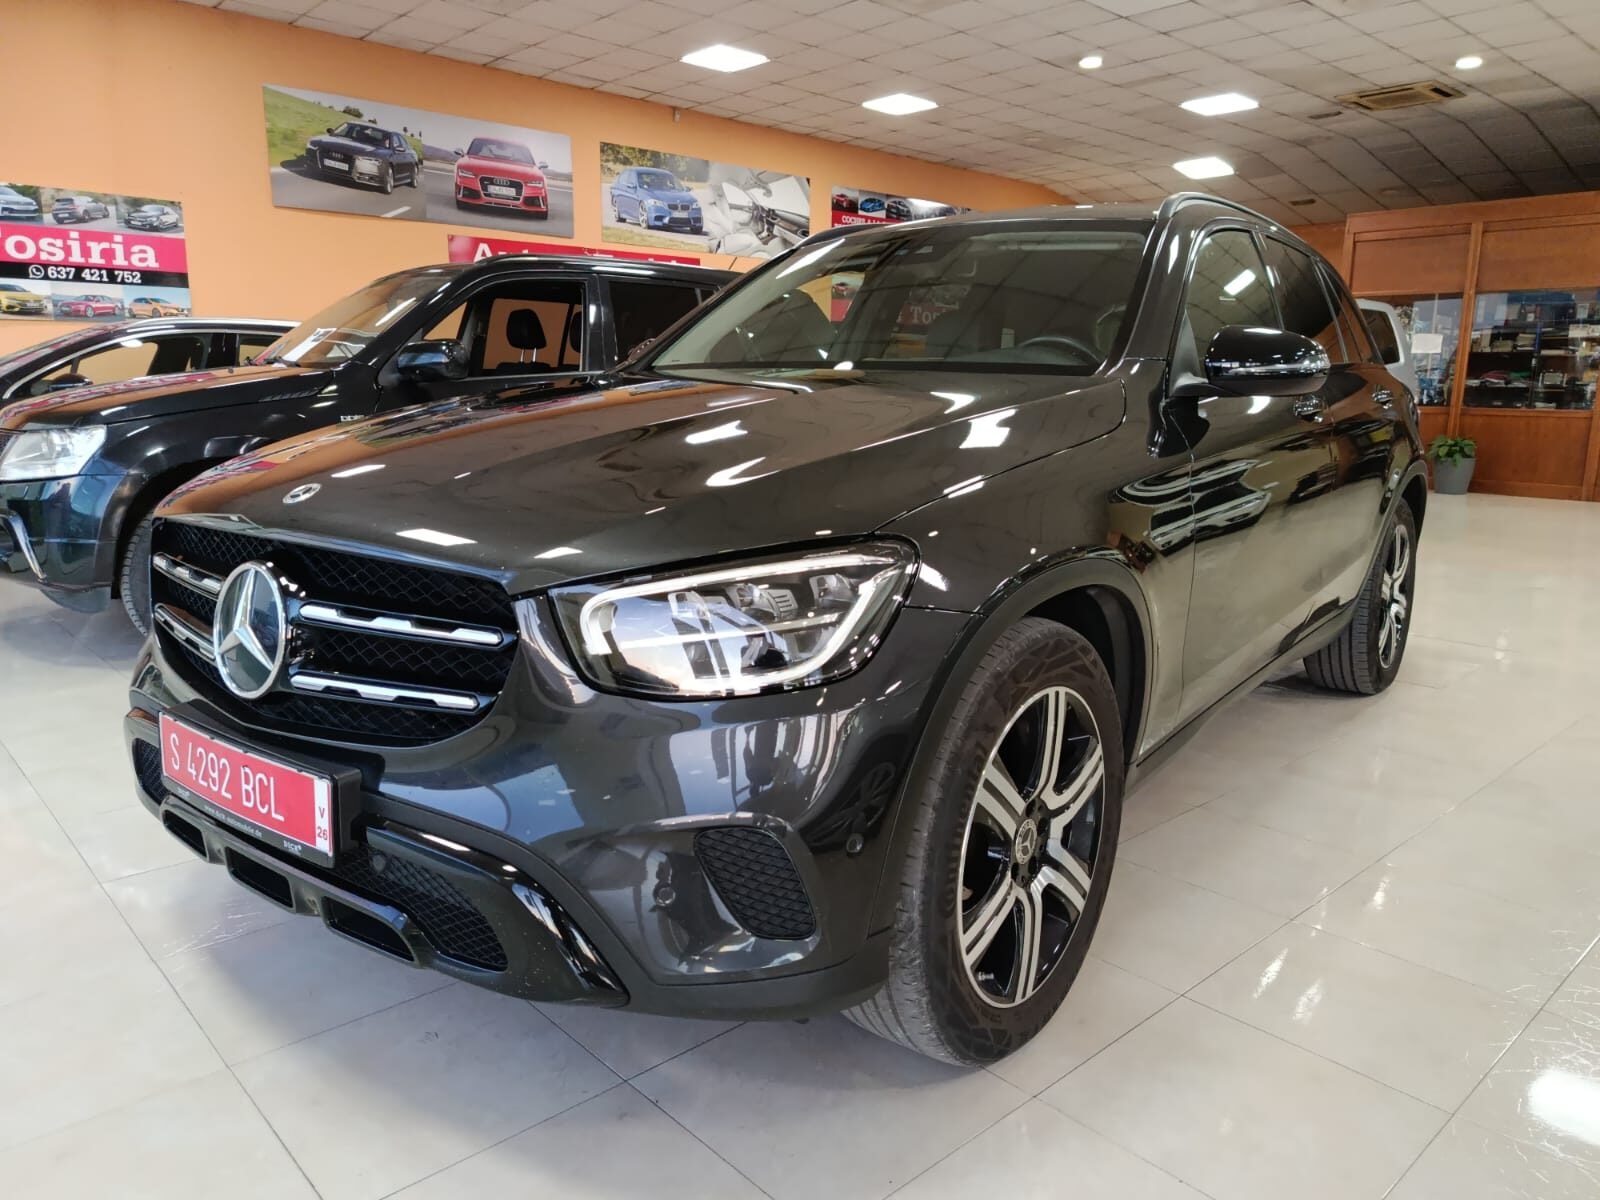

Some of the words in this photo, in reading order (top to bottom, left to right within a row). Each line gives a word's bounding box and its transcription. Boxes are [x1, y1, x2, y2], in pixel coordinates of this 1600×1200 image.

[0, 227, 159, 268] osiria
[48, 266, 75, 279] 637
[81, 269, 109, 282] 421
[114, 271, 142, 284] 752
[170, 733, 180, 770] S
[187, 742, 232, 799] 4292
[240, 766, 284, 821] BCL
[318, 806, 326, 818] V
[317, 826, 328, 841] 26
